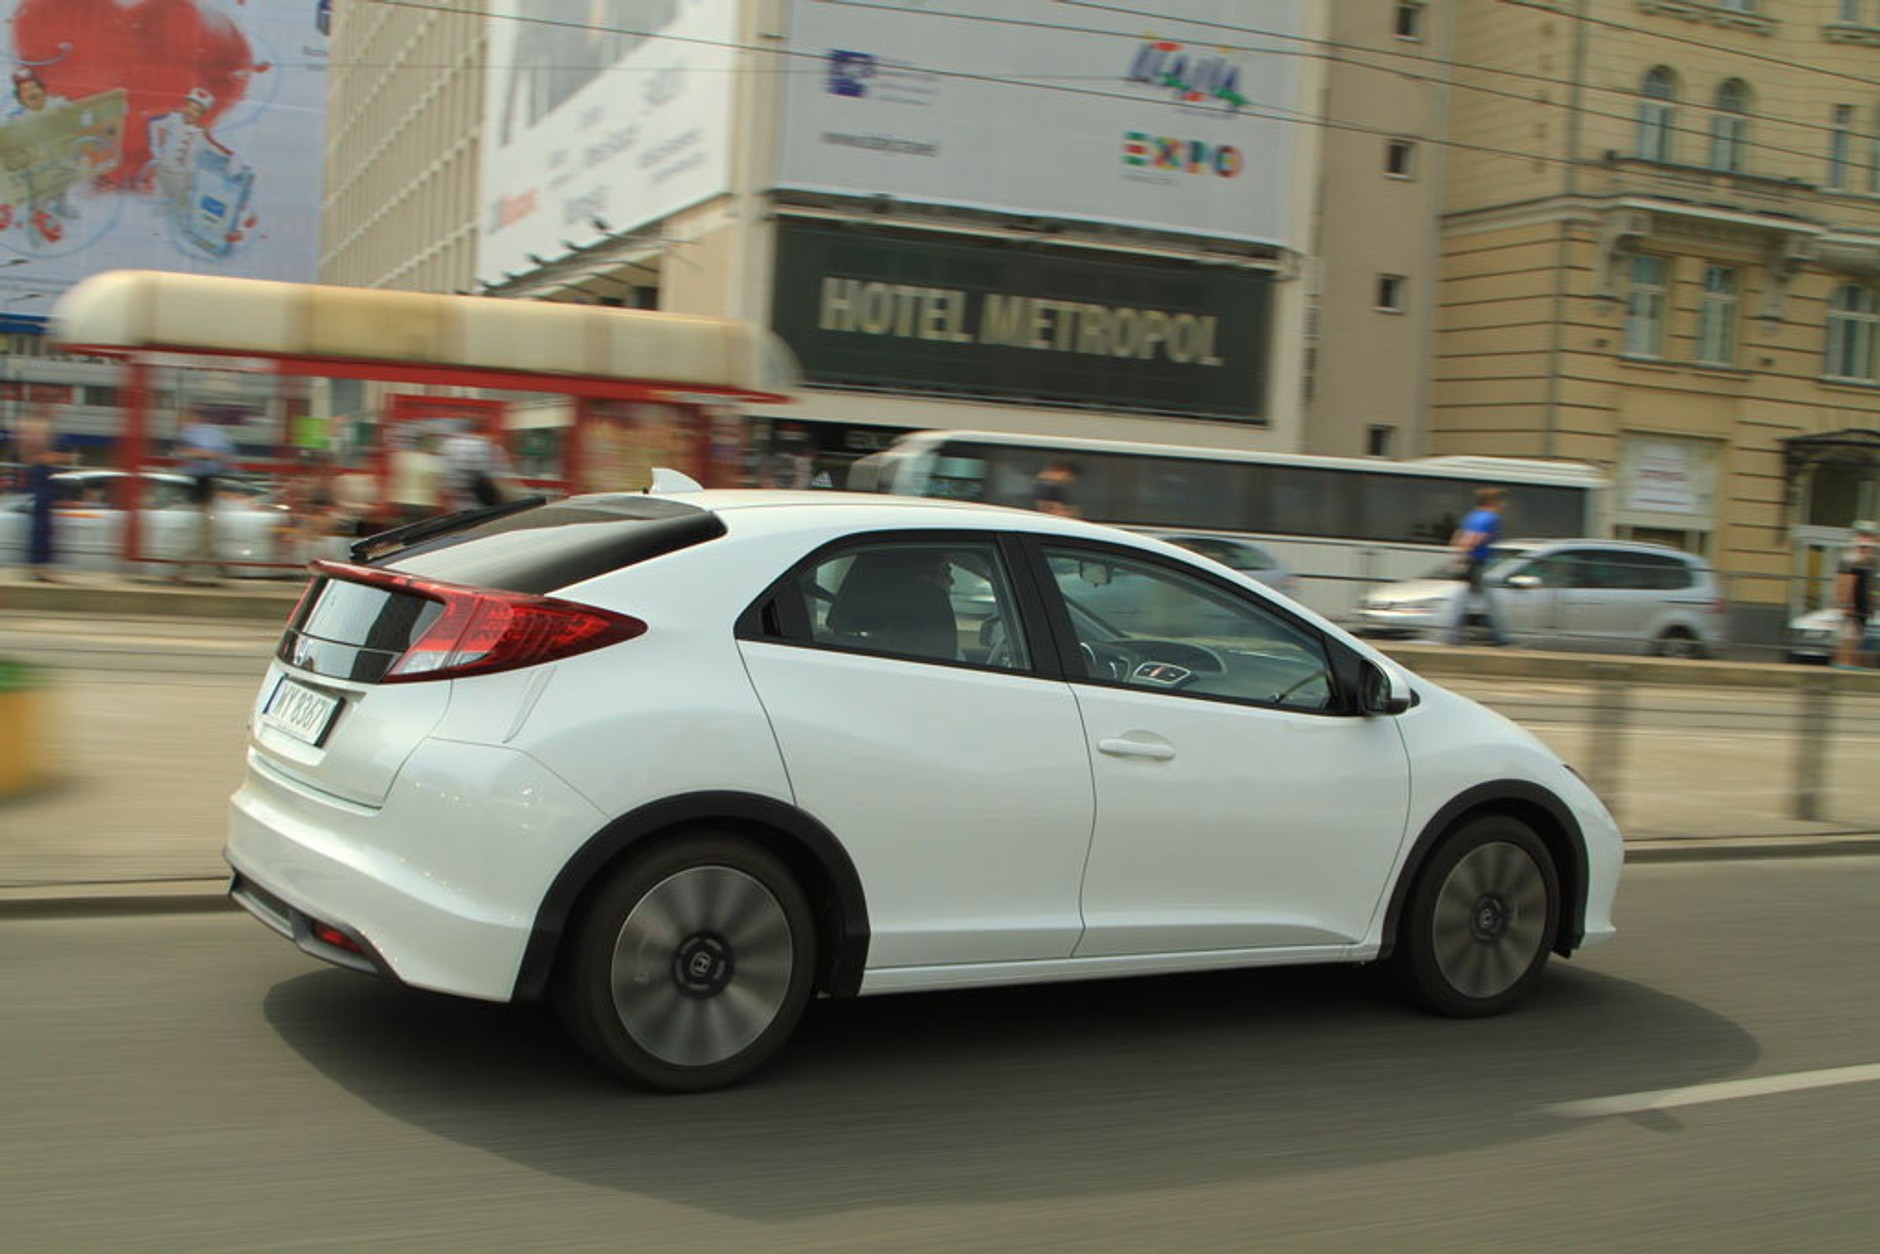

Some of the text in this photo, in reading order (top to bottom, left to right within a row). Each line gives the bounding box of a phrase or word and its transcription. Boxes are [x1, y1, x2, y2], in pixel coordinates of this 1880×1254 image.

[1120, 131, 1244, 178] EXPO
[818, 276, 1223, 366] HOTEL METROPOL
